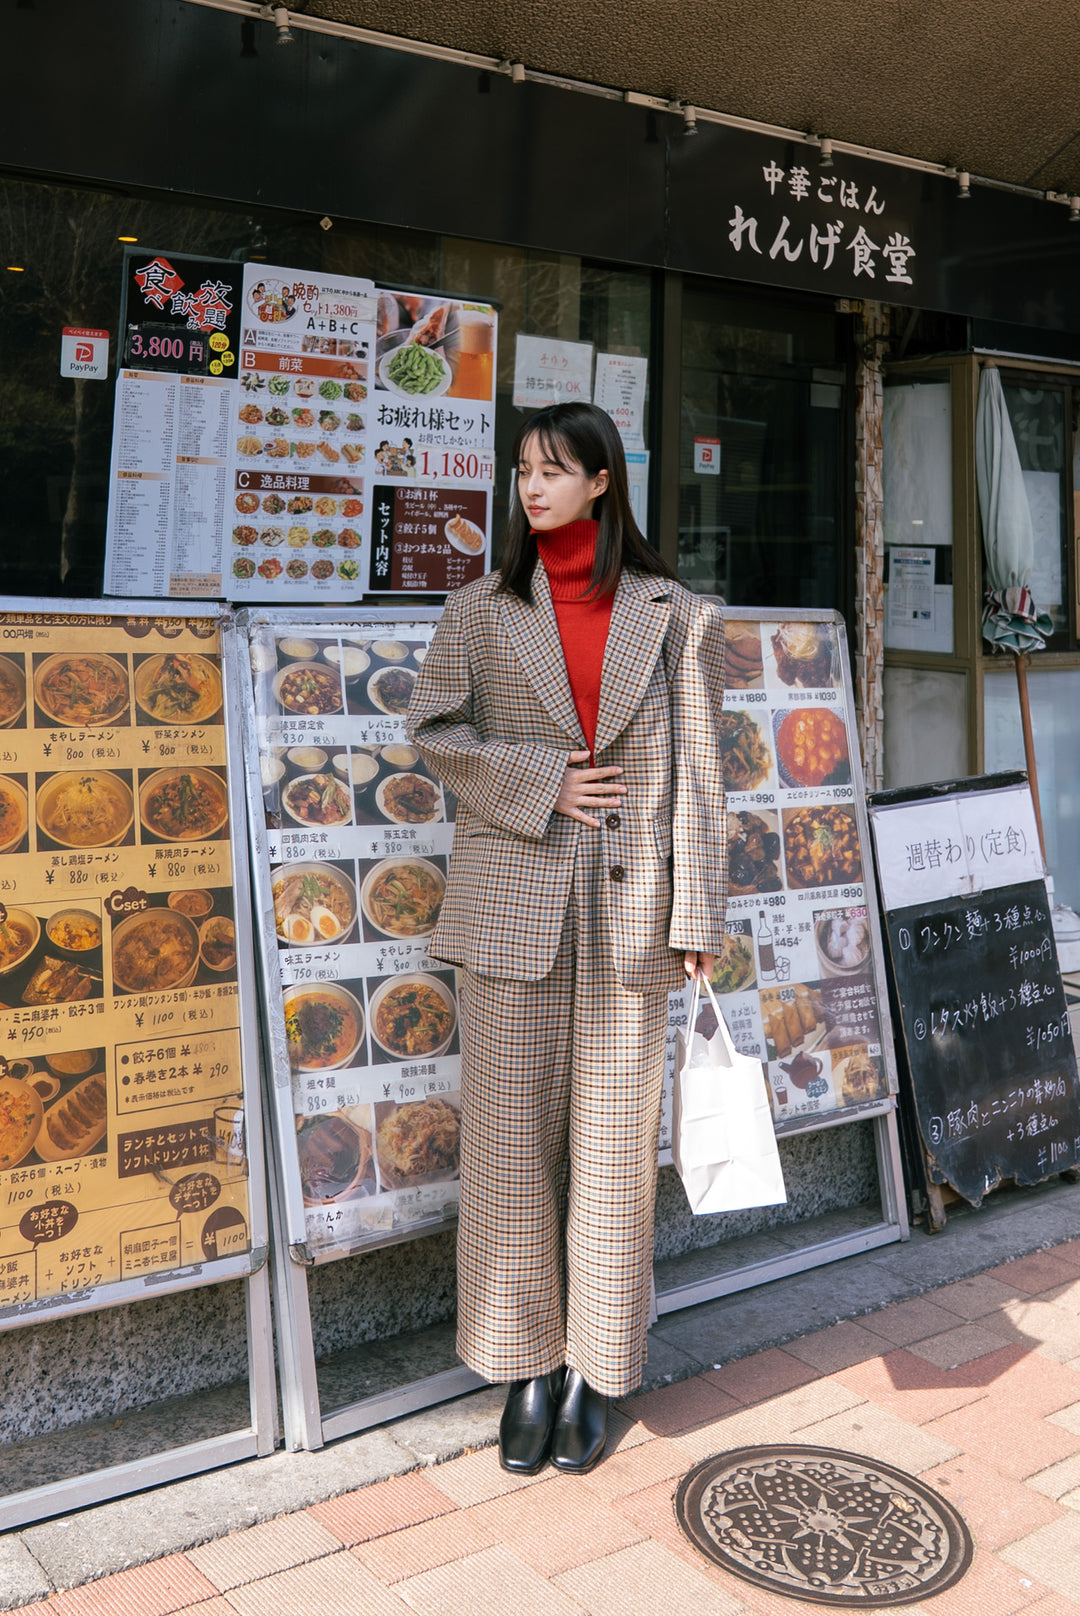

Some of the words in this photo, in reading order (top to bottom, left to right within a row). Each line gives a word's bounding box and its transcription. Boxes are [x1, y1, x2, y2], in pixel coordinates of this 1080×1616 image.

[762, 160, 885, 215] 中華ごはん
[728, 205, 916, 285] れんげ食堂
[200, 279, 233, 331] 放題
[130, 334, 184, 359] 3,800
[70, 363, 98, 373] PayPay
[244, 352, 256, 367] B
[278, 357, 303, 372] 前菜
[565, 381, 581, 393] OK
[377, 404, 491, 434] お疲れ様セット
[238, 472, 250, 488] C
[260, 474, 310, 491] 逸品料理
[375, 502, 391, 577] セット内容
[50, 731, 114, 742] もやしラーメン
[154, 729, 206, 740] 野菜タンメン
[283, 734, 304, 744] 830
[375, 732, 394, 742] 830
[66, 747, 84, 761] 800
[159, 744, 176, 756] 800
[281, 833, 328, 844] 回鍋肉定食
[286, 846, 305, 859] 880
[385, 843, 402, 854] 880
[905, 826, 1027, 872] 週替わり(定食)
[69, 870, 88, 884] 880
[167, 863, 186, 877] 880
[284, 952, 341, 966] 味玉ラーメン
[394, 959, 410, 972] 800
[294, 968, 312, 980] 750
[153, 1011, 174, 1025] 1100
[22, 1026, 44, 1042] 950
[132, 1047, 177, 1064] 餃子6個
[133, 1065, 190, 1085] 春巻き2本
[210, 1063, 229, 1079] 290
[307, 1096, 327, 1112] 880
[123, 1126, 209, 1153] ランチとセットで
[8, 1189, 33, 1204] 1100
[45, 1183, 81, 1199] (税込)
[30, 1205, 69, 1221] お好きな
[35, 1218, 64, 1231] 小丼を
[223, 1232, 245, 1247] 1100
[59, 1245, 104, 1262] お好きな
[66, 1261, 97, 1275] ソフト
[60, 1274, 103, 1291] ドリンク
